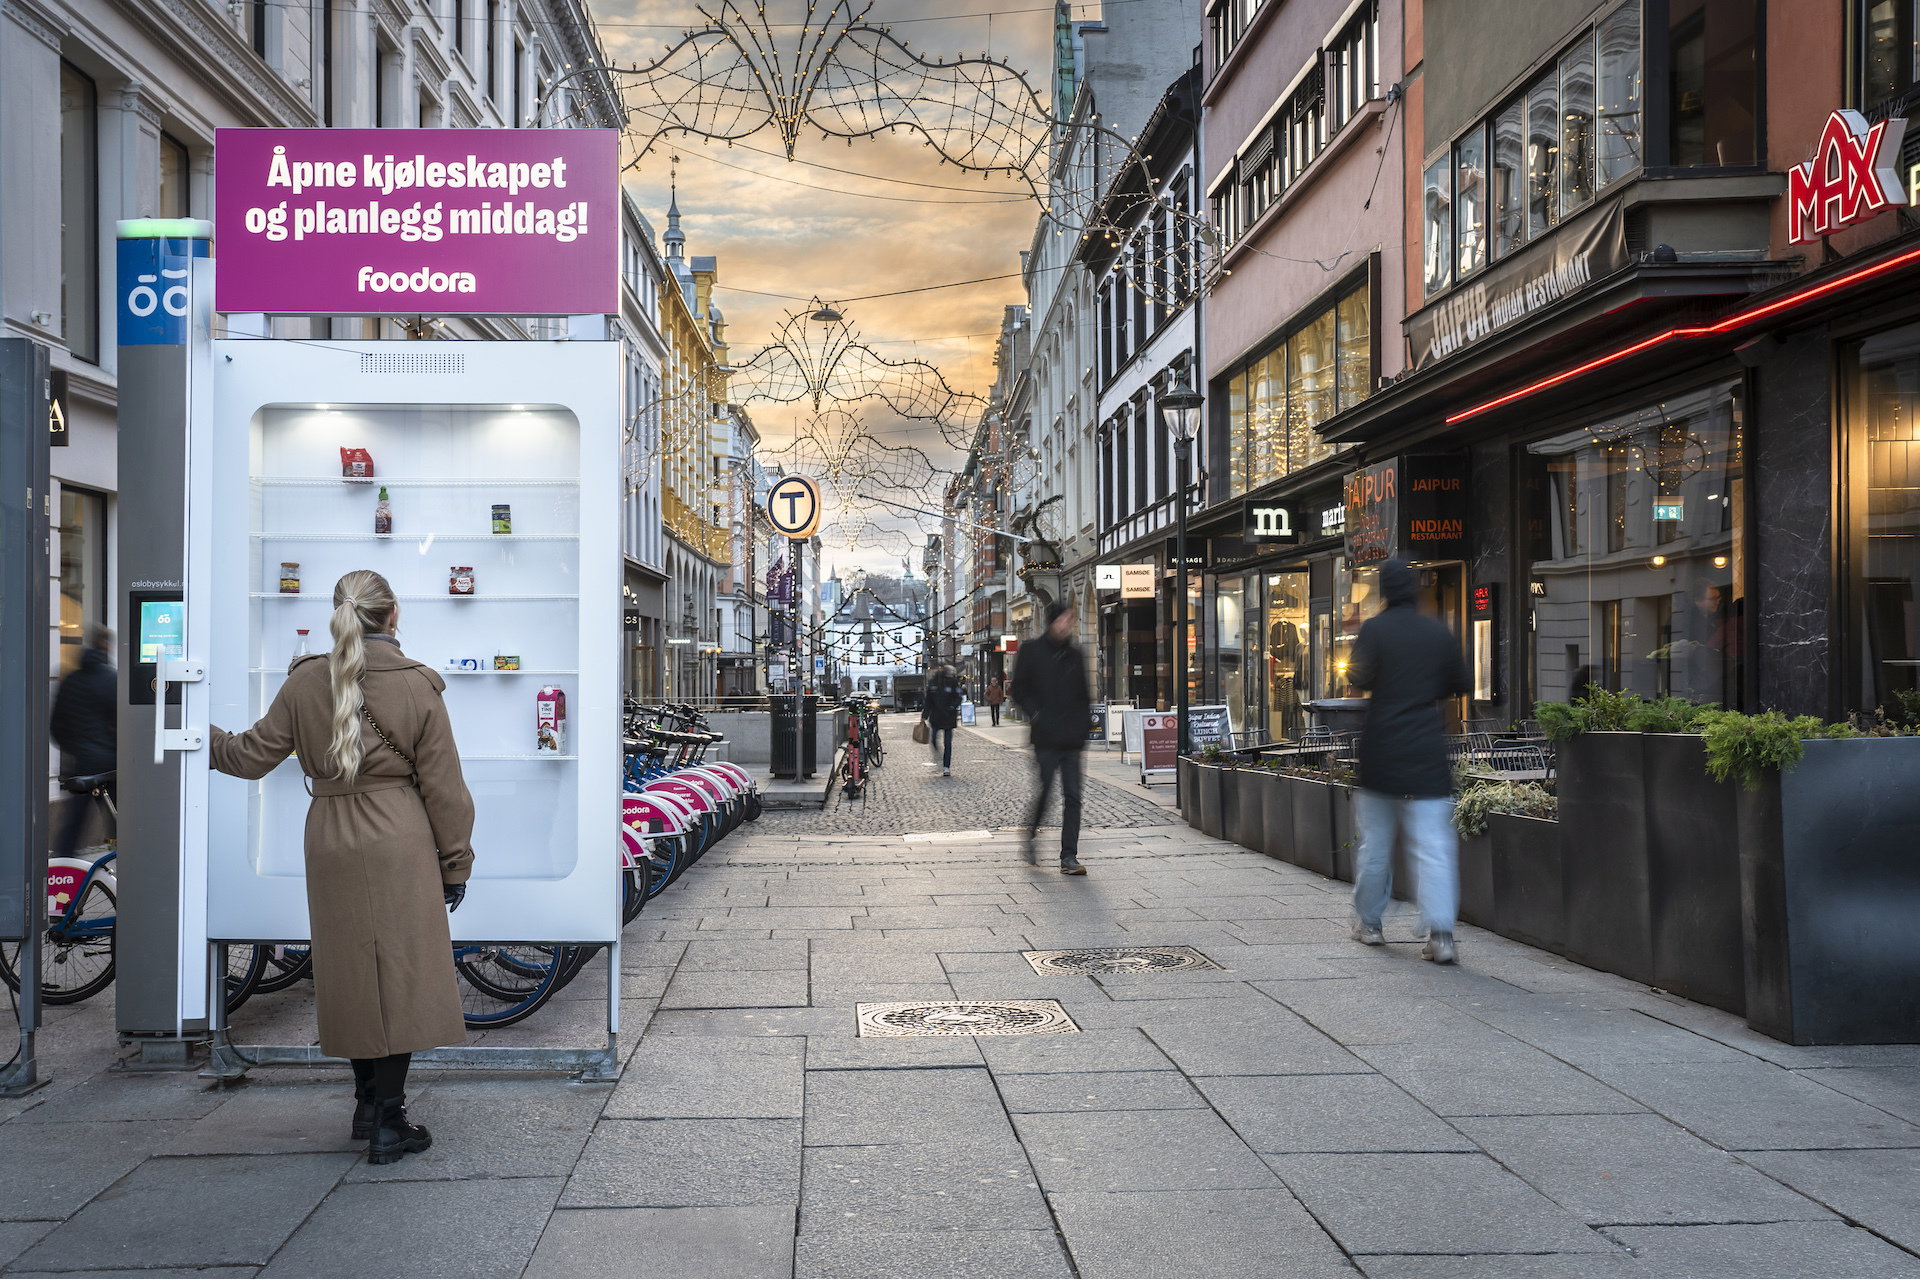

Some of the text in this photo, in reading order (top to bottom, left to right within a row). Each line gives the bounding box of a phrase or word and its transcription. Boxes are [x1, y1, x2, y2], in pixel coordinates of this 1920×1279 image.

[266, 145, 567, 195] Åpne kjøleskapet
[1788, 110, 1888, 245] MAX
[245, 200, 589, 242] og planlegg middag!
[357, 266, 476, 293] foodora
[1430, 250, 1592, 360] JAIPUR INDIAN RESTAURANT
[1346, 468, 1395, 511] JAIPUR
[1412, 478, 1460, 491] JAIPUR
[780, 491, 805, 524] T
[1253, 507, 1292, 536] m
[1411, 519, 1463, 532] INDIAN
[1411, 532, 1463, 540] RESTAURANT
[48, 874, 74, 886] dora
